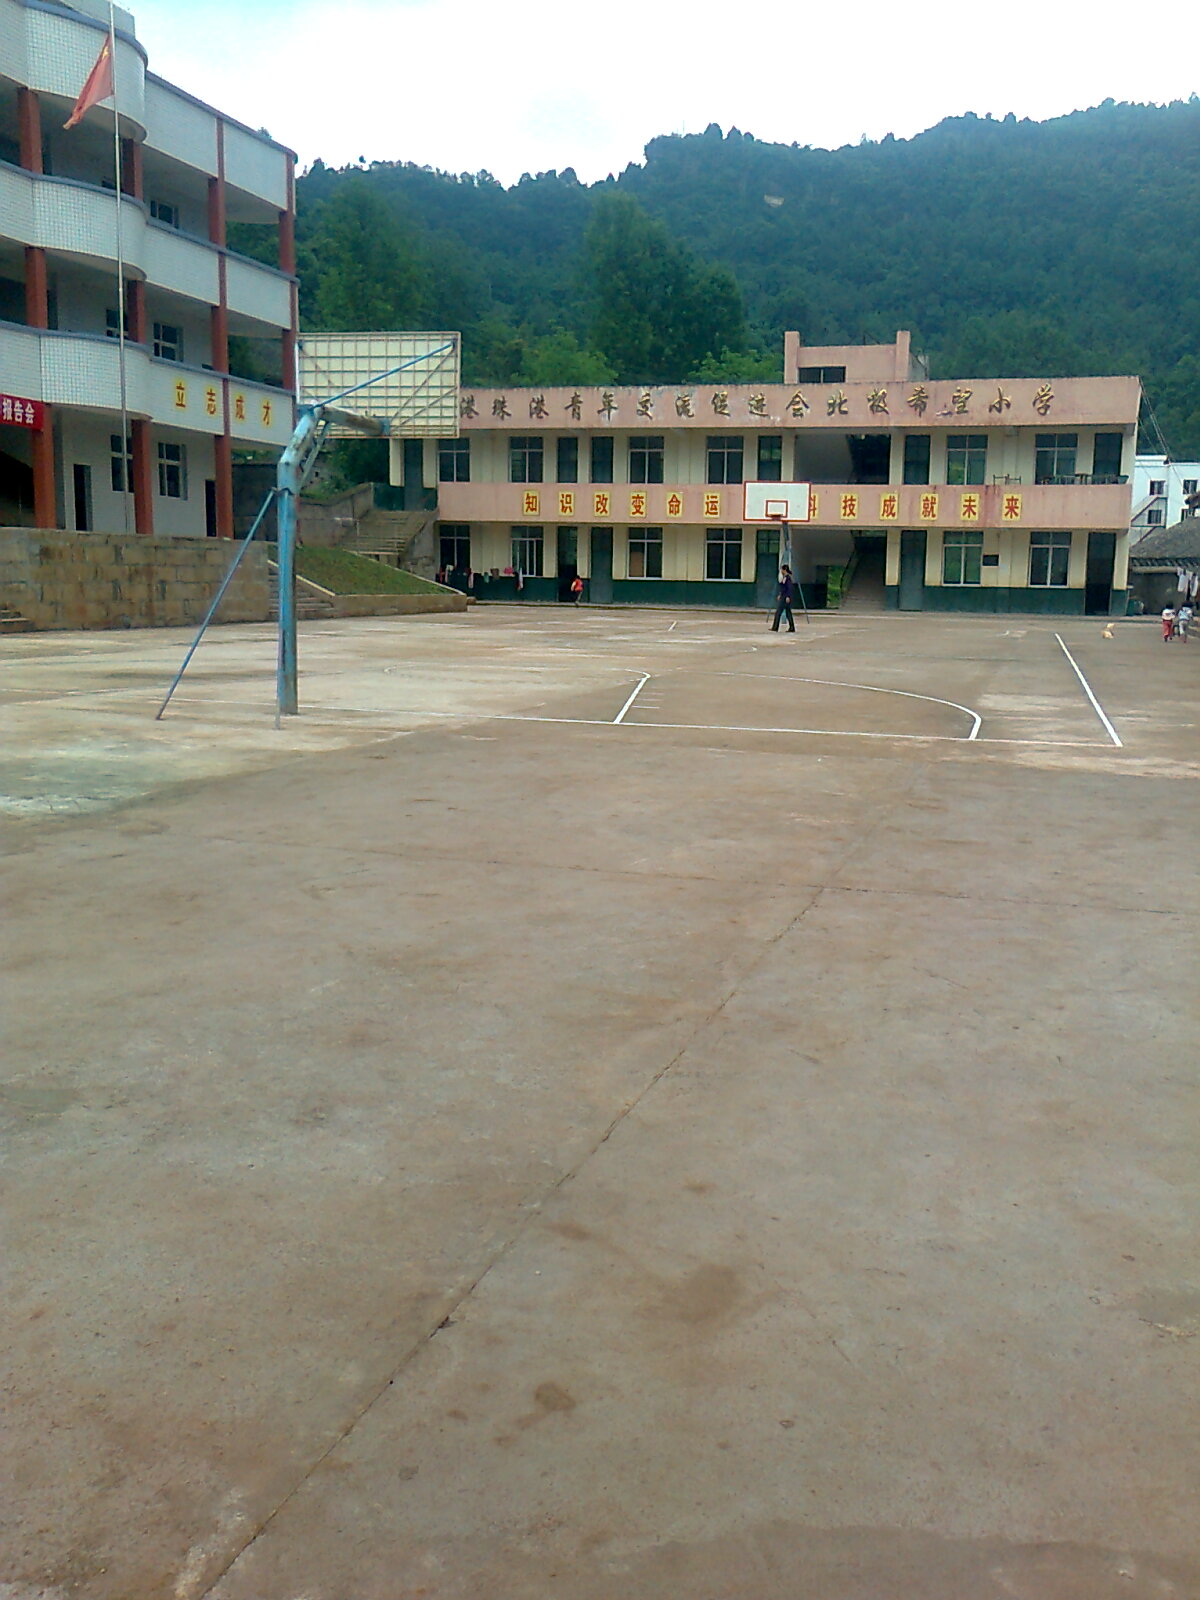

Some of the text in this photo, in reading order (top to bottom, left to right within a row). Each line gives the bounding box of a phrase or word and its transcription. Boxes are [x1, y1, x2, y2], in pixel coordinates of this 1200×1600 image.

[2, 398, 35, 424] 报告会
[176, 383, 271, 425] 立志成才
[525, 493, 719, 516] 知识改变命运
